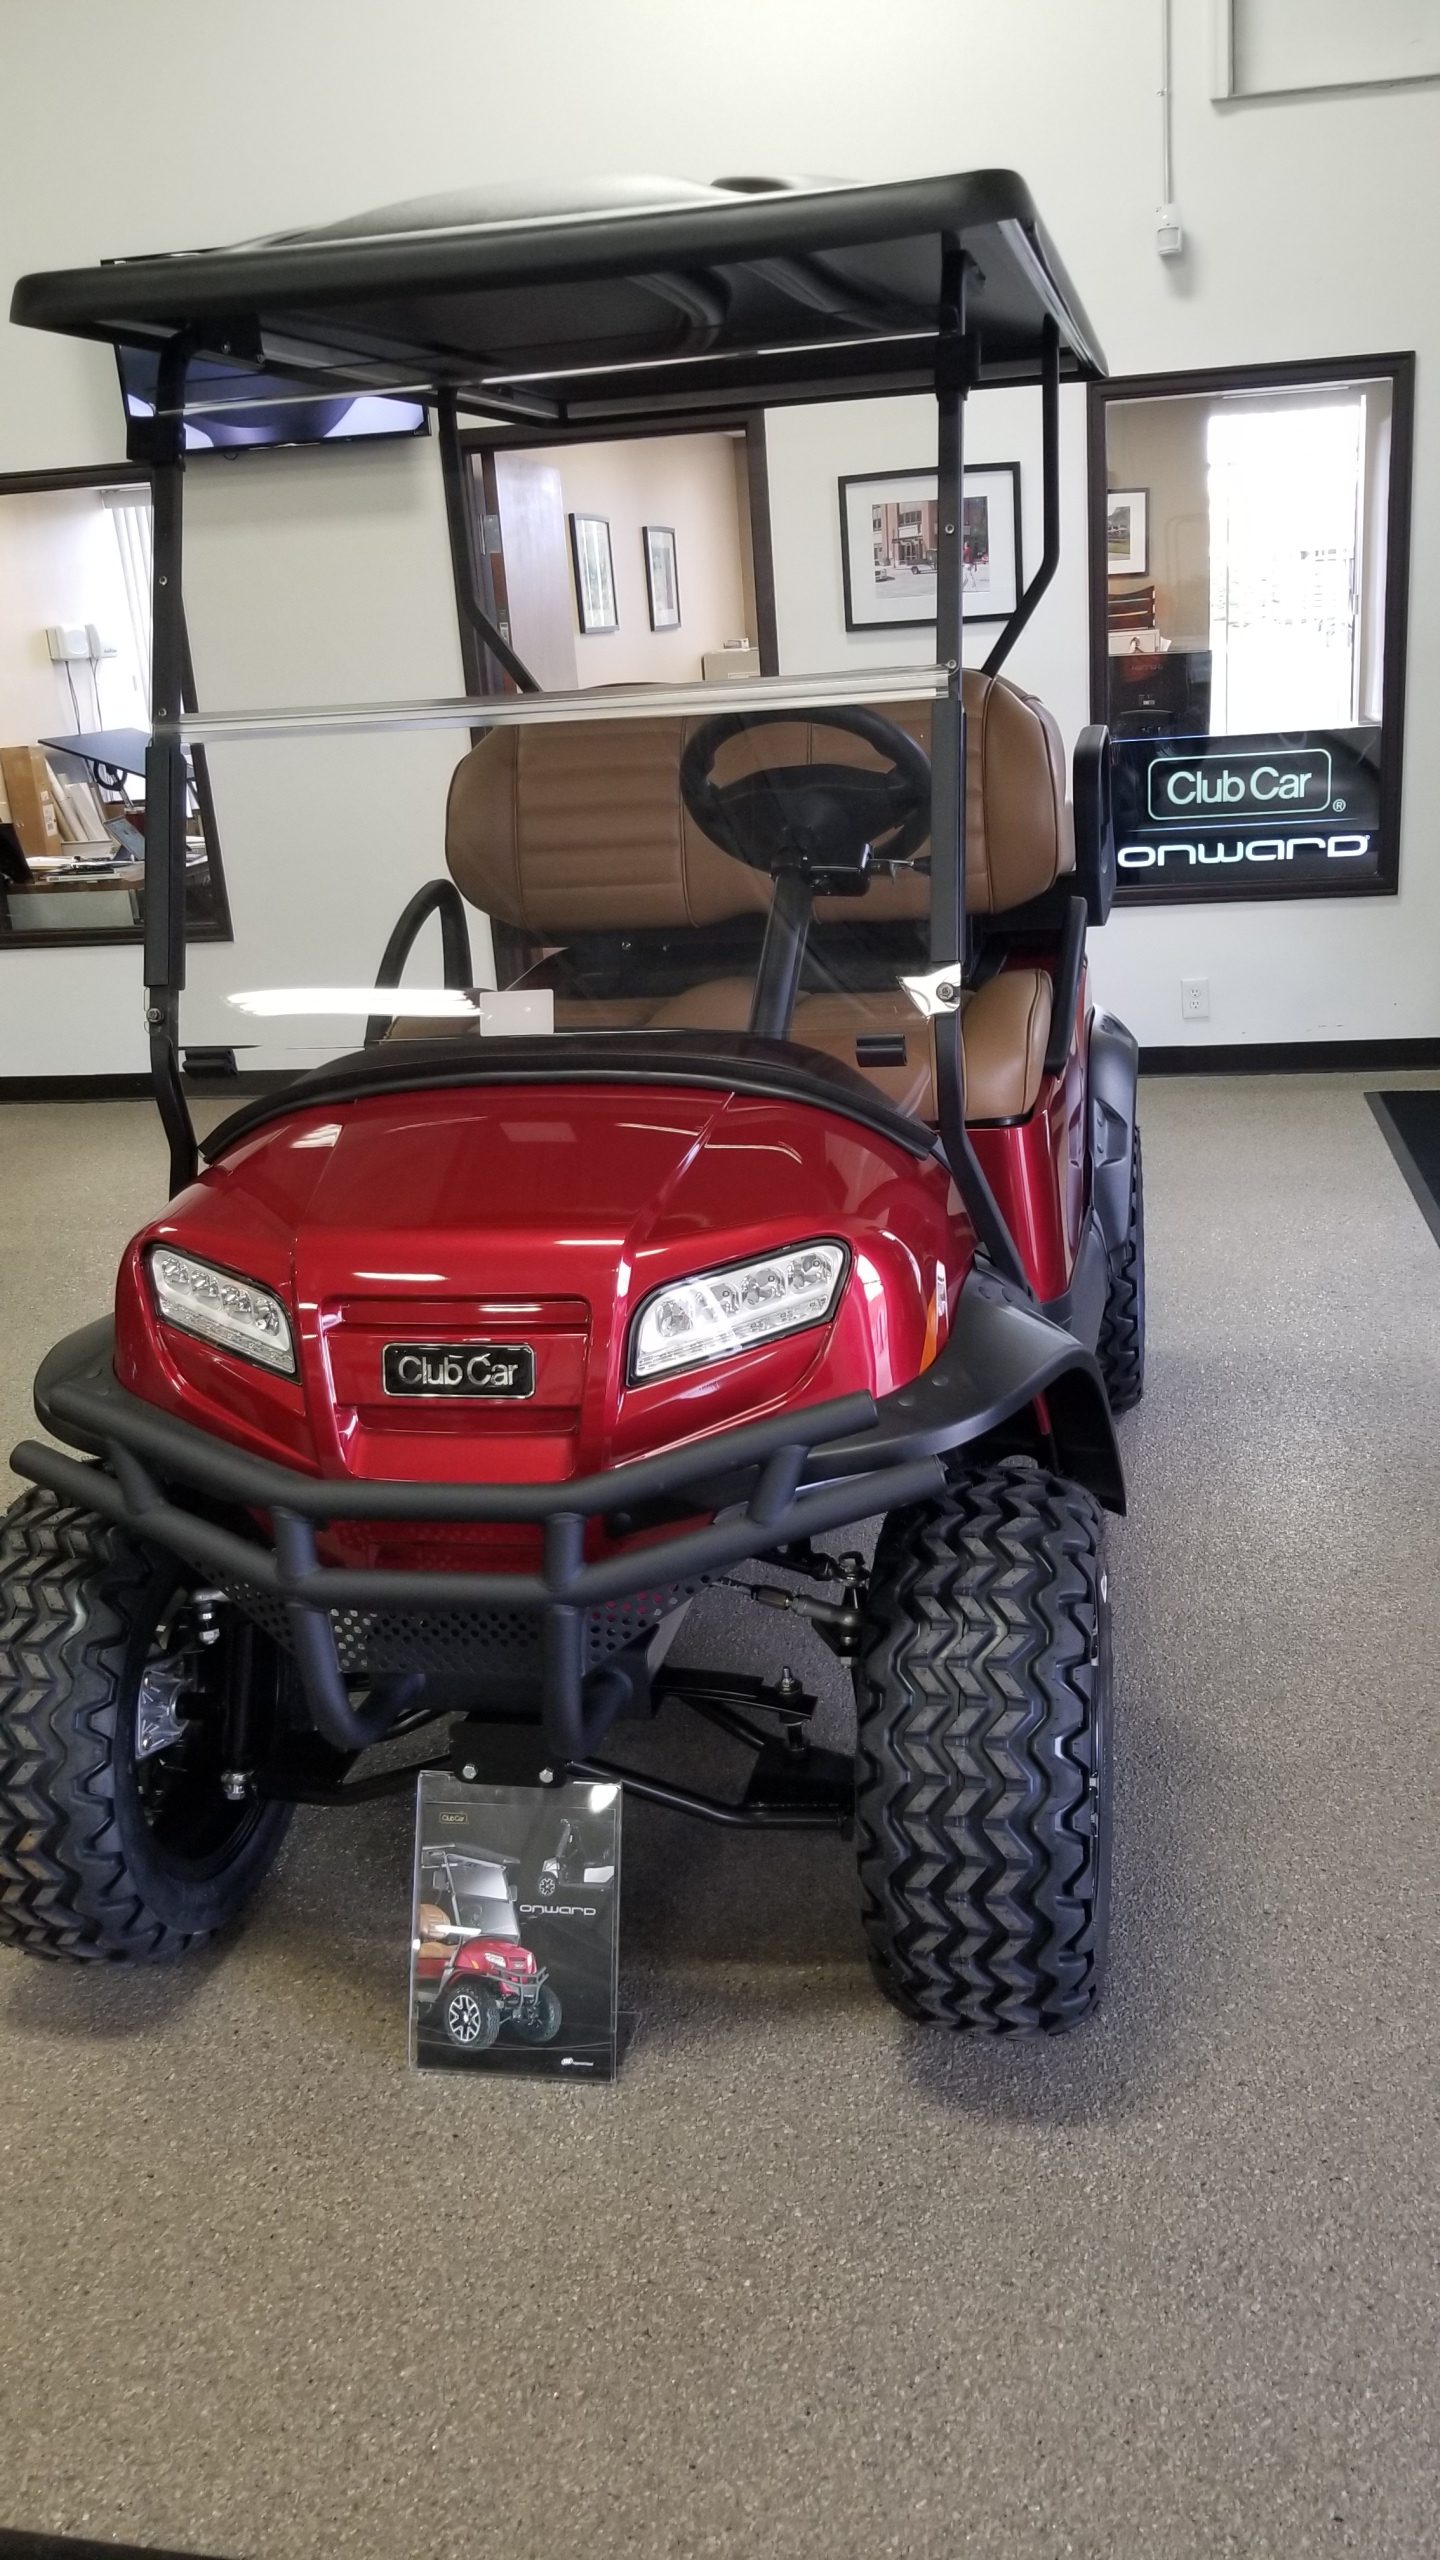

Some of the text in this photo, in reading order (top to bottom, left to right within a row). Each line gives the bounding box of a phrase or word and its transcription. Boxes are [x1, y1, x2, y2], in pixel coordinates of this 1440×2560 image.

[1166, 769, 1246, 805] Club
[1249, 766, 1312, 801] Car
[398, 1354, 519, 1386] Club Car
